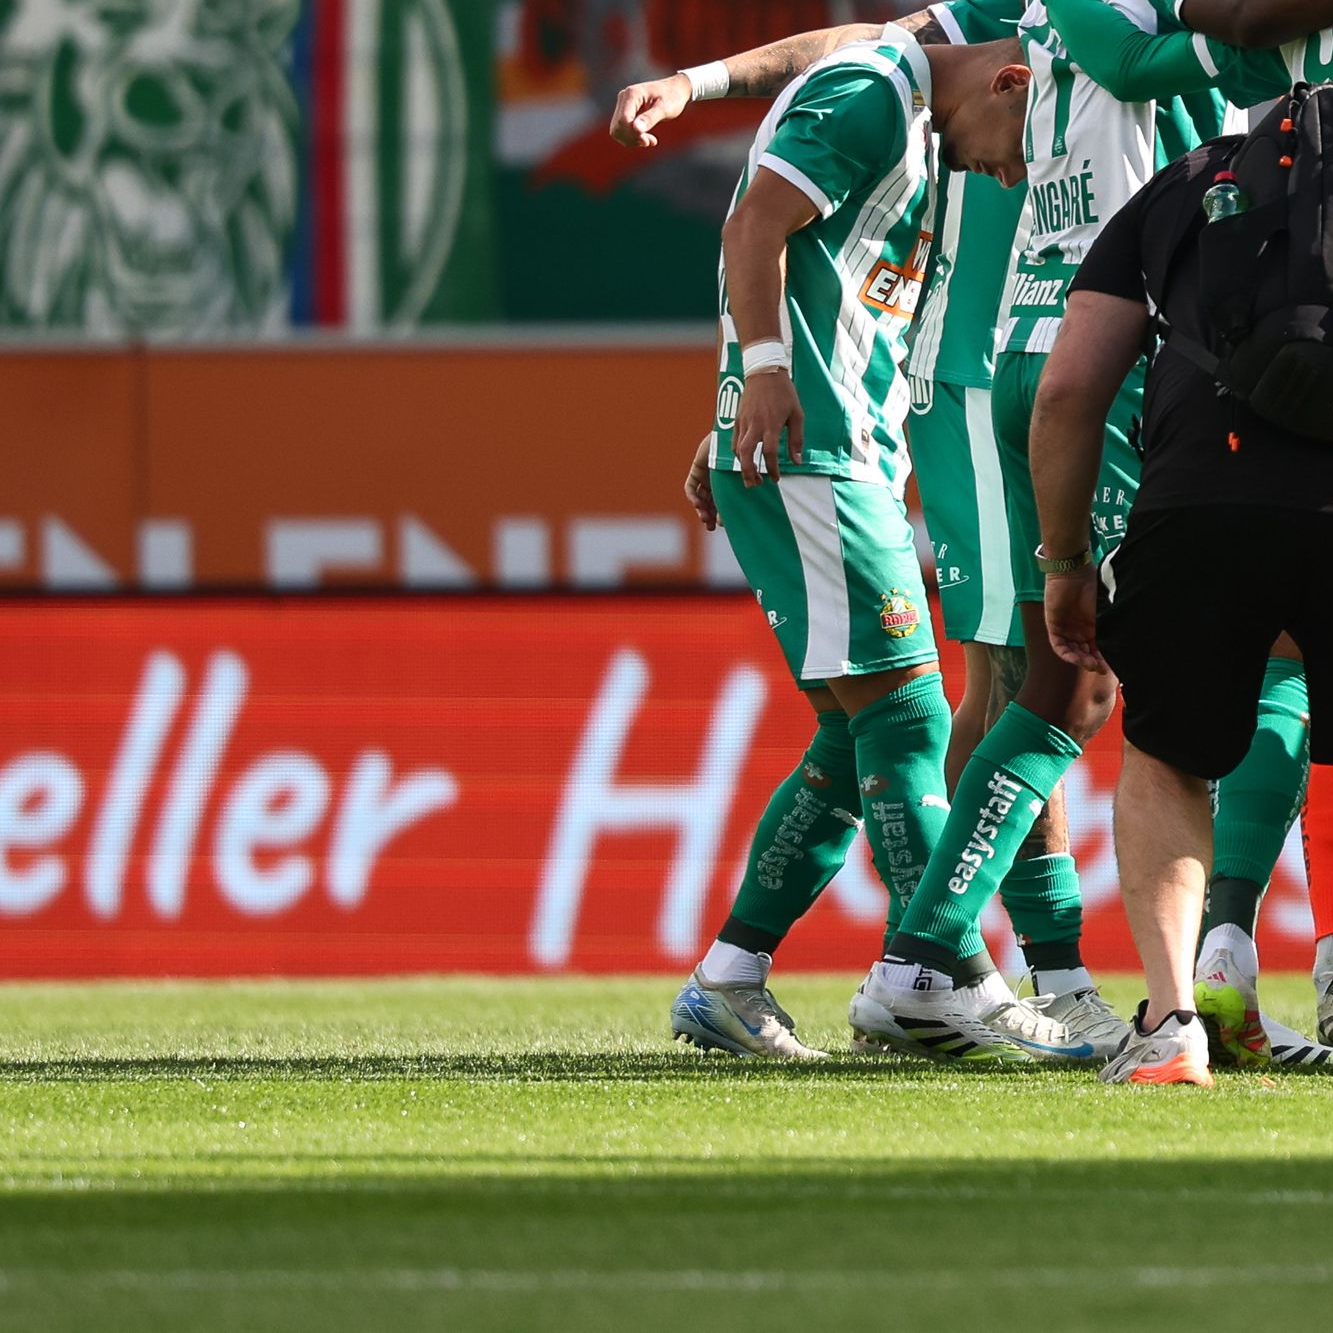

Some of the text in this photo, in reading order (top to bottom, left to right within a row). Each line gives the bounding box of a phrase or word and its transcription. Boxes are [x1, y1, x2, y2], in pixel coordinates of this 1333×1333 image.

[1031, 159, 1099, 236] NGARÉ
[757, 787, 827, 891] easystaff
[871, 801, 926, 908] systaff
[948, 771, 1023, 895] easystaff
